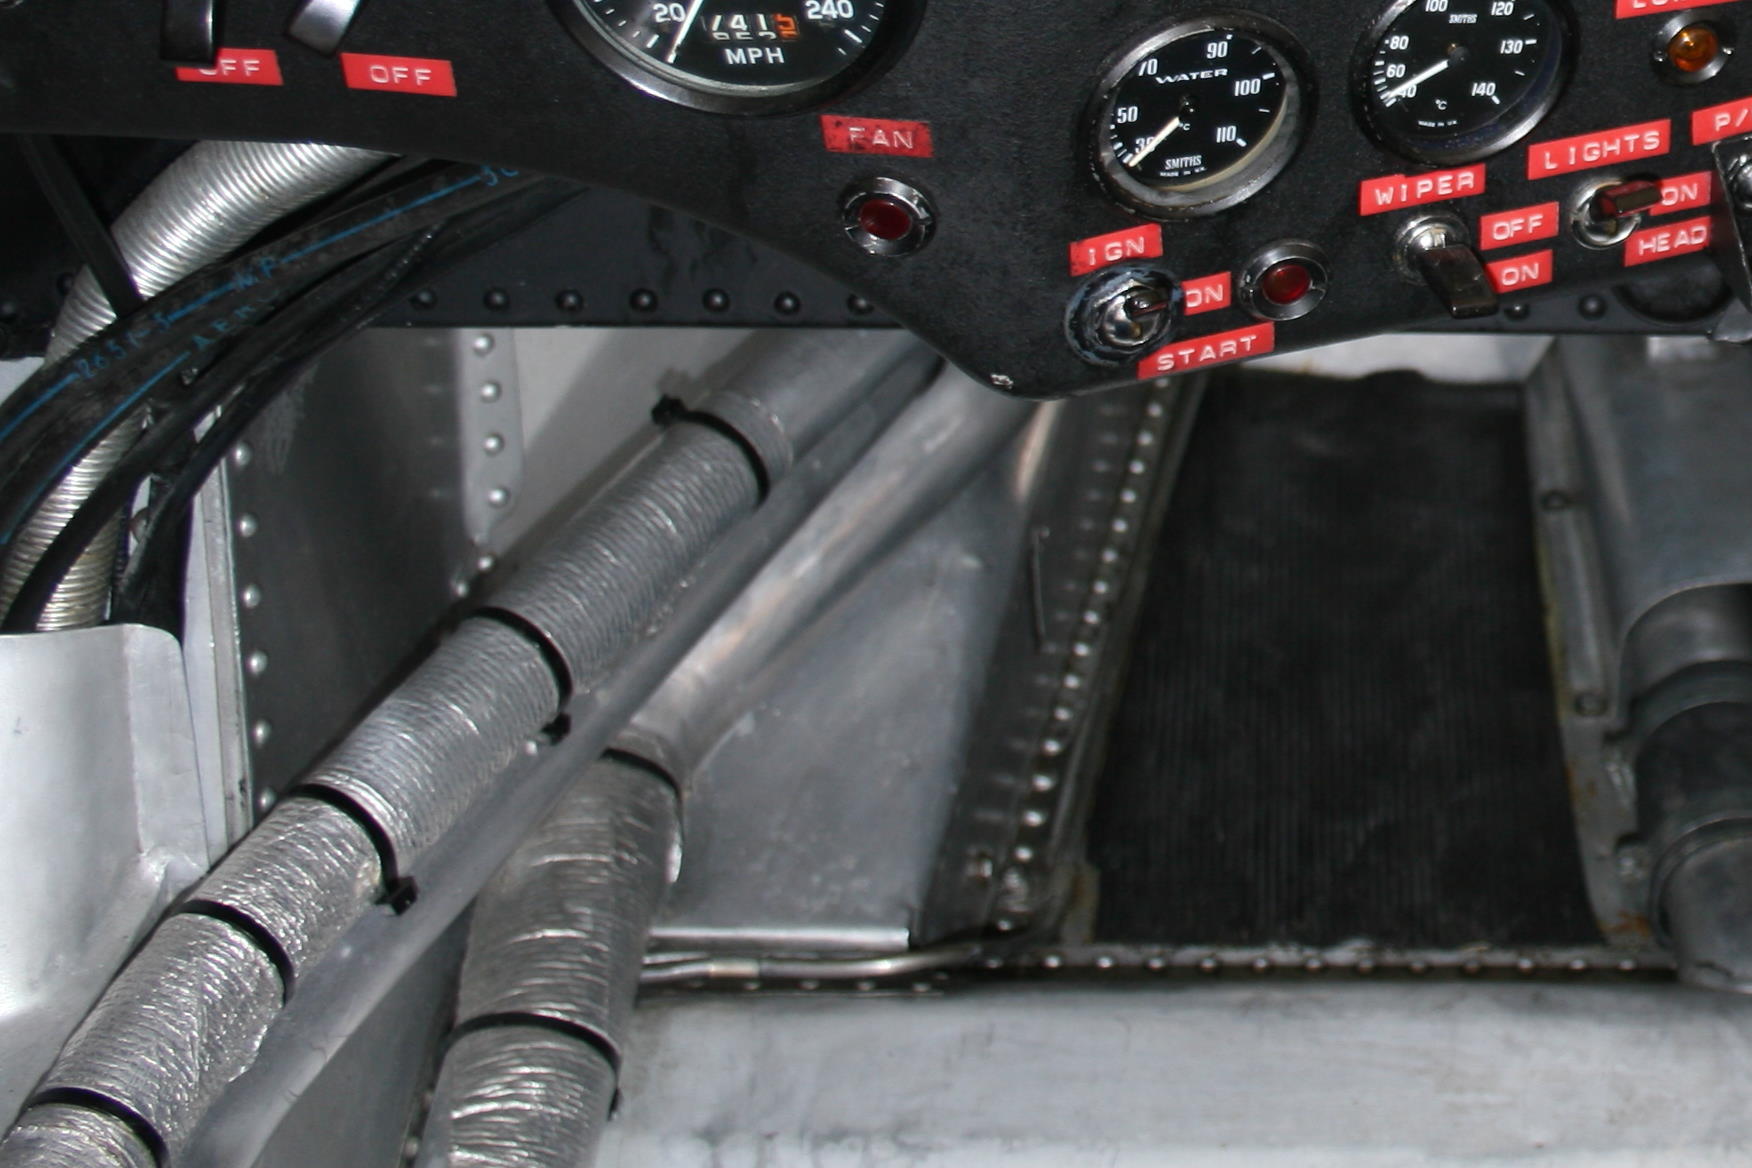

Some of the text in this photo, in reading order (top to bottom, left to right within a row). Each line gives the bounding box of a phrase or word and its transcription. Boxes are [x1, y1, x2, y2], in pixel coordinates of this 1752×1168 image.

[652, 3, 686, 24] 20
[805, 0, 855, 20] 240
[1491, 2, 1514, 16] 120
[1206, 41, 1228, 59] 90
[1389, 36, 1409, 50] 80
[1500, 40, 1523, 54] 130
[725, 47, 784, 66] MPH
[370, 65, 432, 86] OFF
[1156, 68, 1228, 84] WATER
[1386, 64, 1406, 78] 60
[1234, 79, 1261, 97] 100
[1471, 82, 1496, 96] 140
[1117, 106, 1138, 124] 50
[849, 128, 913, 151] FAN
[1216, 125, 1237, 143] 110
[1544, 130, 1661, 171] LIGHTS
[1165, 155, 1202, 170] SMITHS
[1375, 171, 1474, 206] WIPER
[1661, 183, 1699, 206] ON
[1492, 214, 1544, 240] OFF
[1639, 225, 1707, 256] HEAD
[1088, 237, 1145, 266] IGN
[1501, 262, 1539, 286] ON
[1185, 284, 1223, 308] ON
[1157, 335, 1257, 371] START
